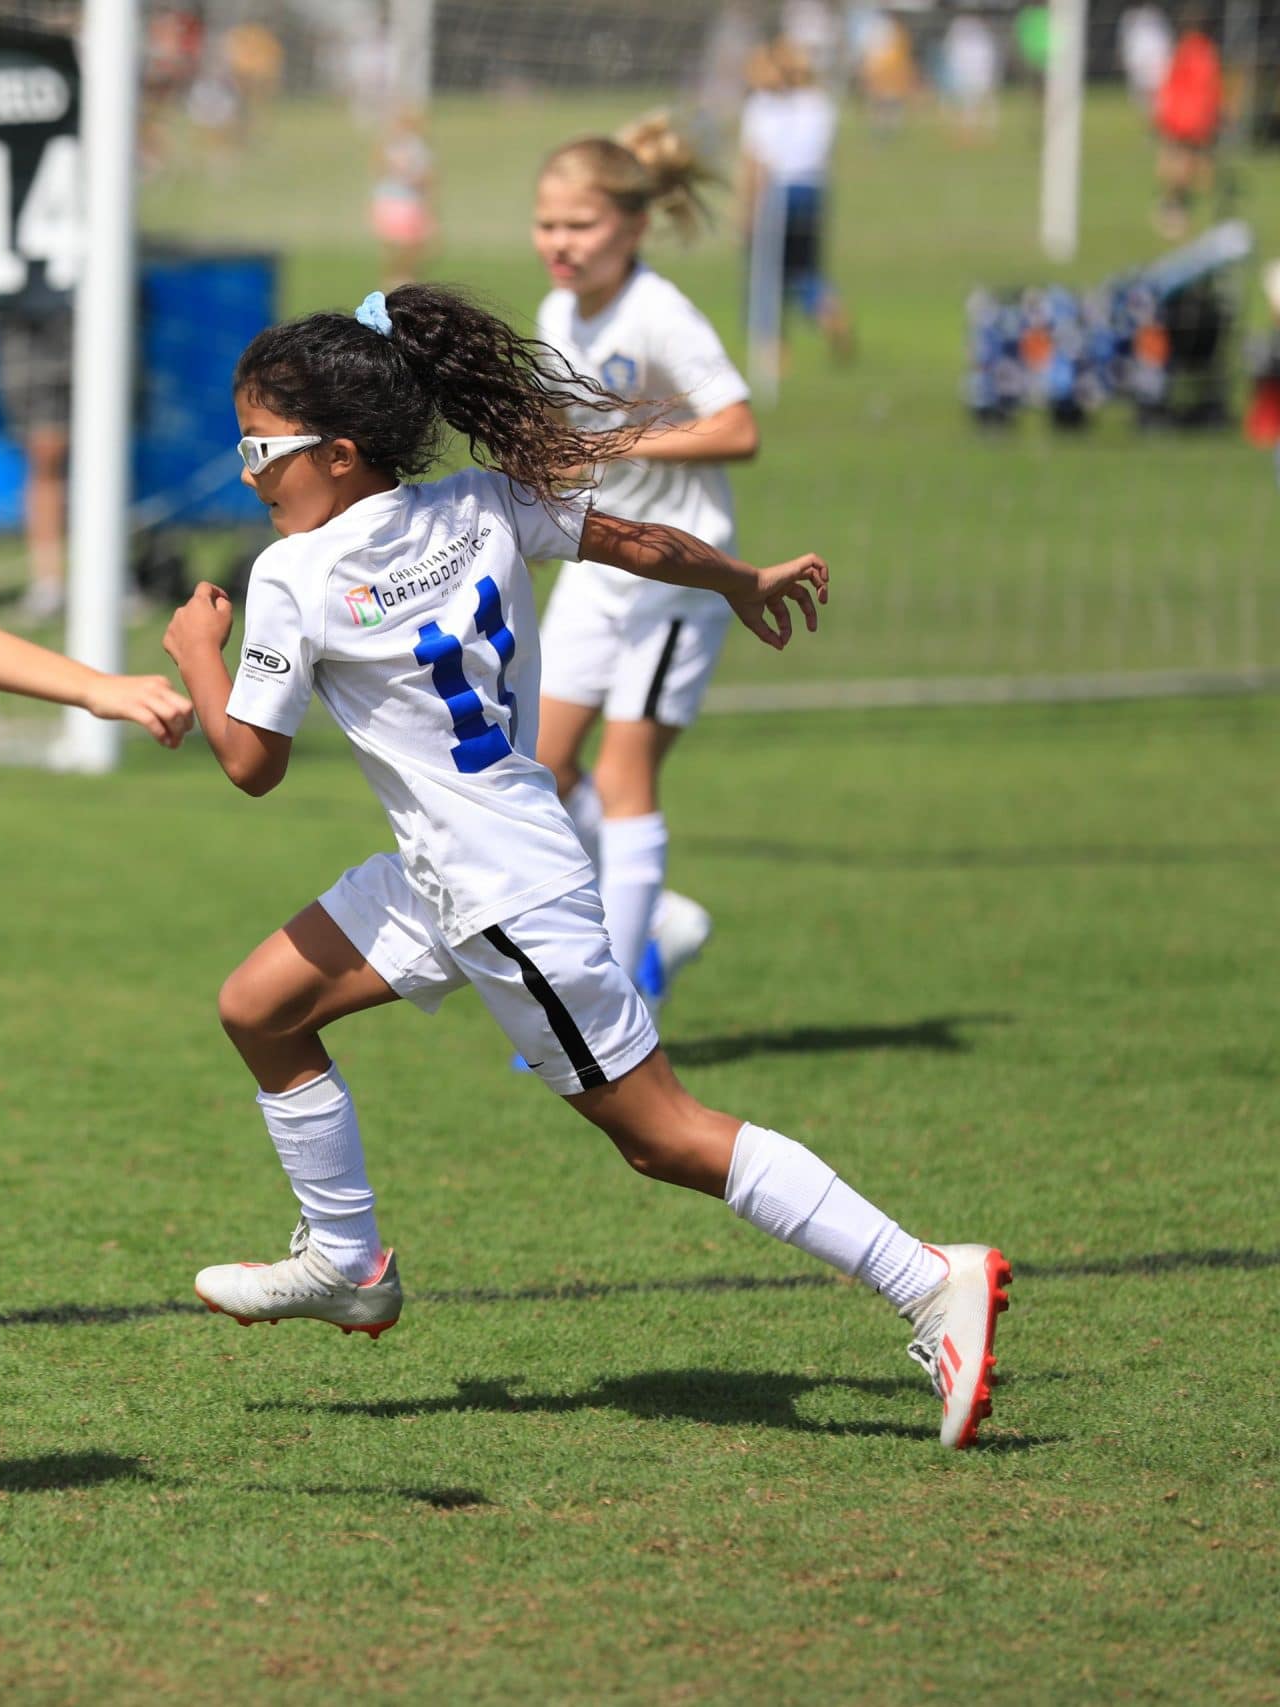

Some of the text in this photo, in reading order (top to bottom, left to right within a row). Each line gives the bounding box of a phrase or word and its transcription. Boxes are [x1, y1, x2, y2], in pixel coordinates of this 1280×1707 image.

[382, 527, 492, 607] ORTHODONTICS
[389, 549, 449, 584] CHRISTIAN
[245, 647, 281, 669] RG
[413, 575, 518, 774] 11
